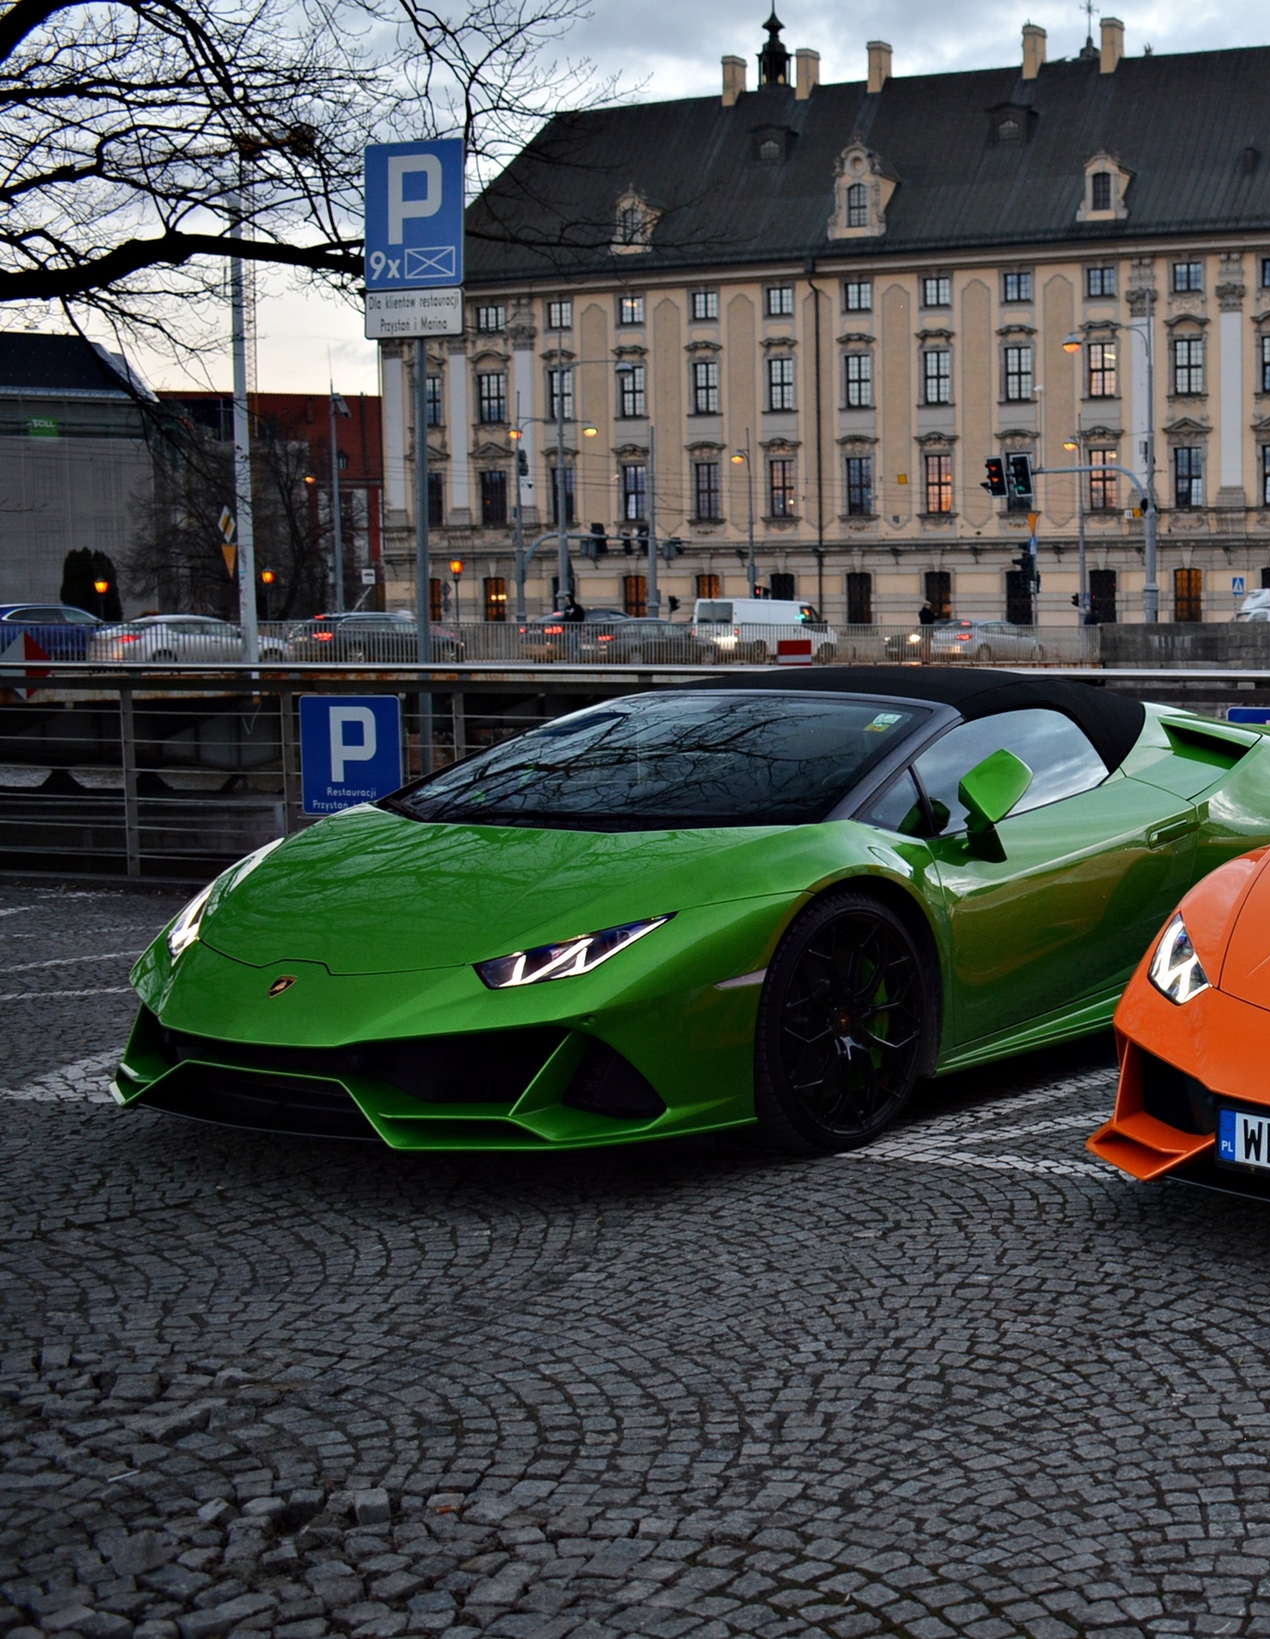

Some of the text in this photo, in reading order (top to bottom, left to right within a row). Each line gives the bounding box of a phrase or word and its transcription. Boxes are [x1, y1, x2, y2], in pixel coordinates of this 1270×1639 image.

[388, 153, 443, 245] P
[369, 250, 401, 281] 9x
[368, 291, 459, 310] Dla klientów restauracji
[380, 316, 411, 335] Przystań
[421, 316, 448, 331] Marina
[329, 706, 377, 783] P
[326, 786, 377, 799] Restauracji
[1221, 1139, 1234, 1153] PL
